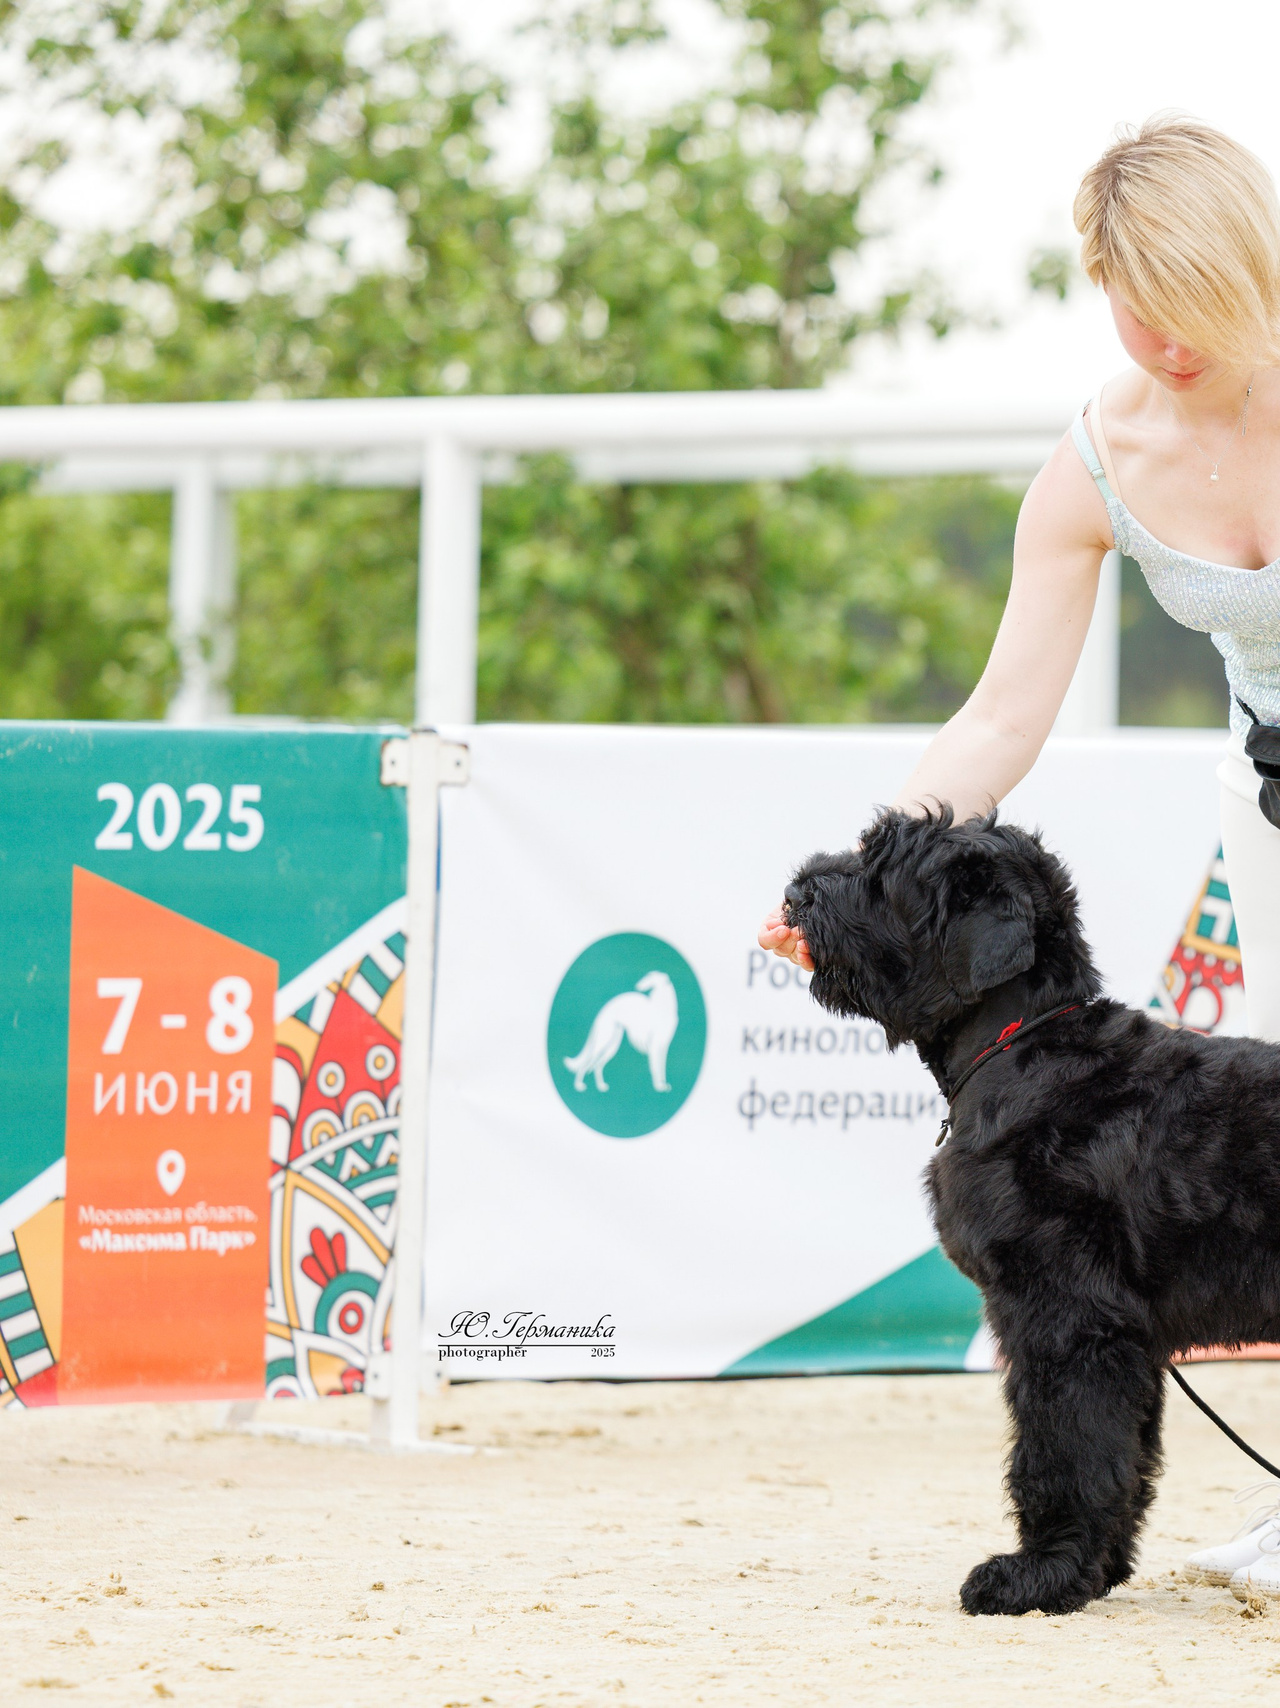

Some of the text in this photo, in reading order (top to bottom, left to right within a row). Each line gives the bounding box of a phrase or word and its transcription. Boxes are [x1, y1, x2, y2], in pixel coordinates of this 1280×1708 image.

[94, 783, 265, 851] 2025
[97, 977, 143, 1055] 7
[205, 976, 254, 1055] 8
[94, 1070, 254, 1115] ИЮНЯ
[79, 1205, 182, 1225] Московская
[79, 1225, 256, 1256] «Максима Парк»
